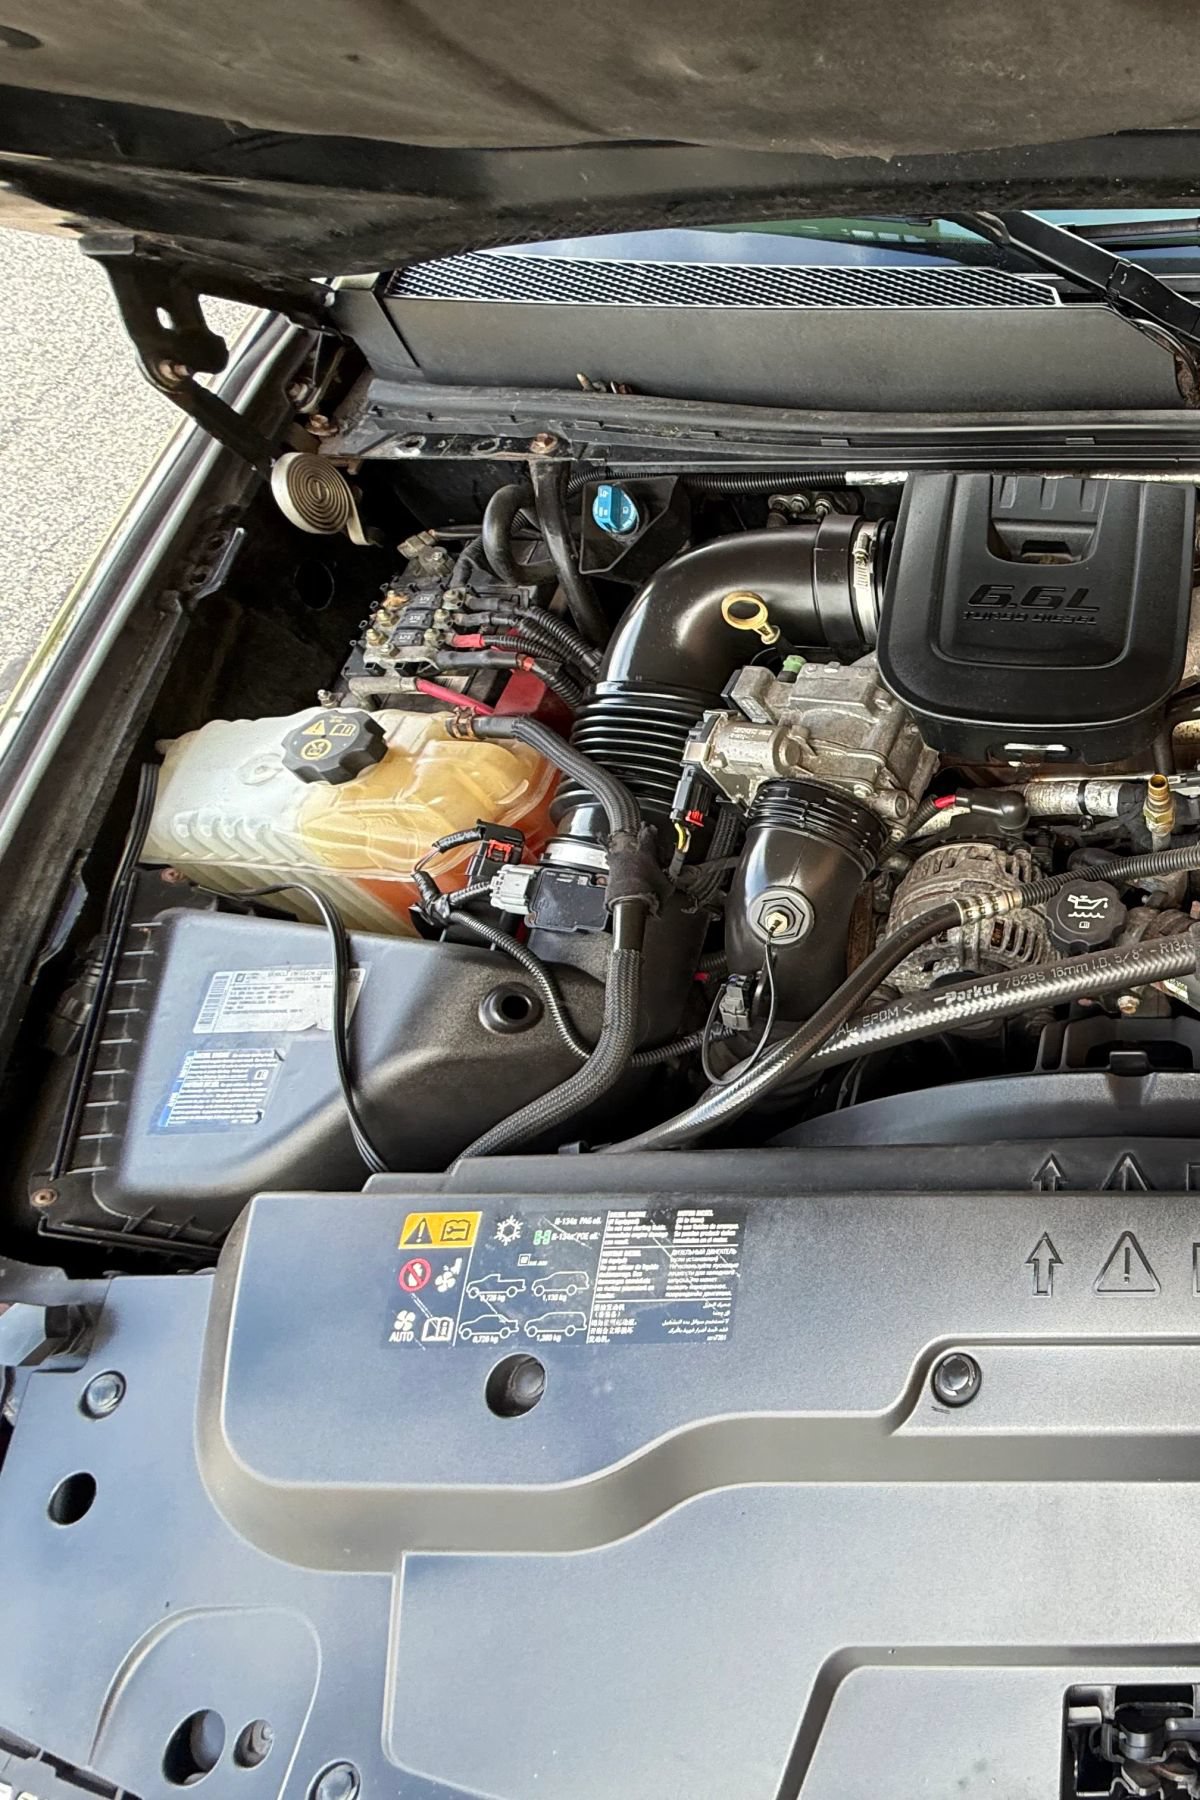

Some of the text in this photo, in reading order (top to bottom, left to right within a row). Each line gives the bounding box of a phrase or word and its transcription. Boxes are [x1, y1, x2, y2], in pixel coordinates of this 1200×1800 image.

[968, 584, 1100, 612] 6.6L
[943, 982, 999, 1005] Parker
[862, 1006, 898, 1027] EPDM
[388, 1331, 414, 1342] AUTO
